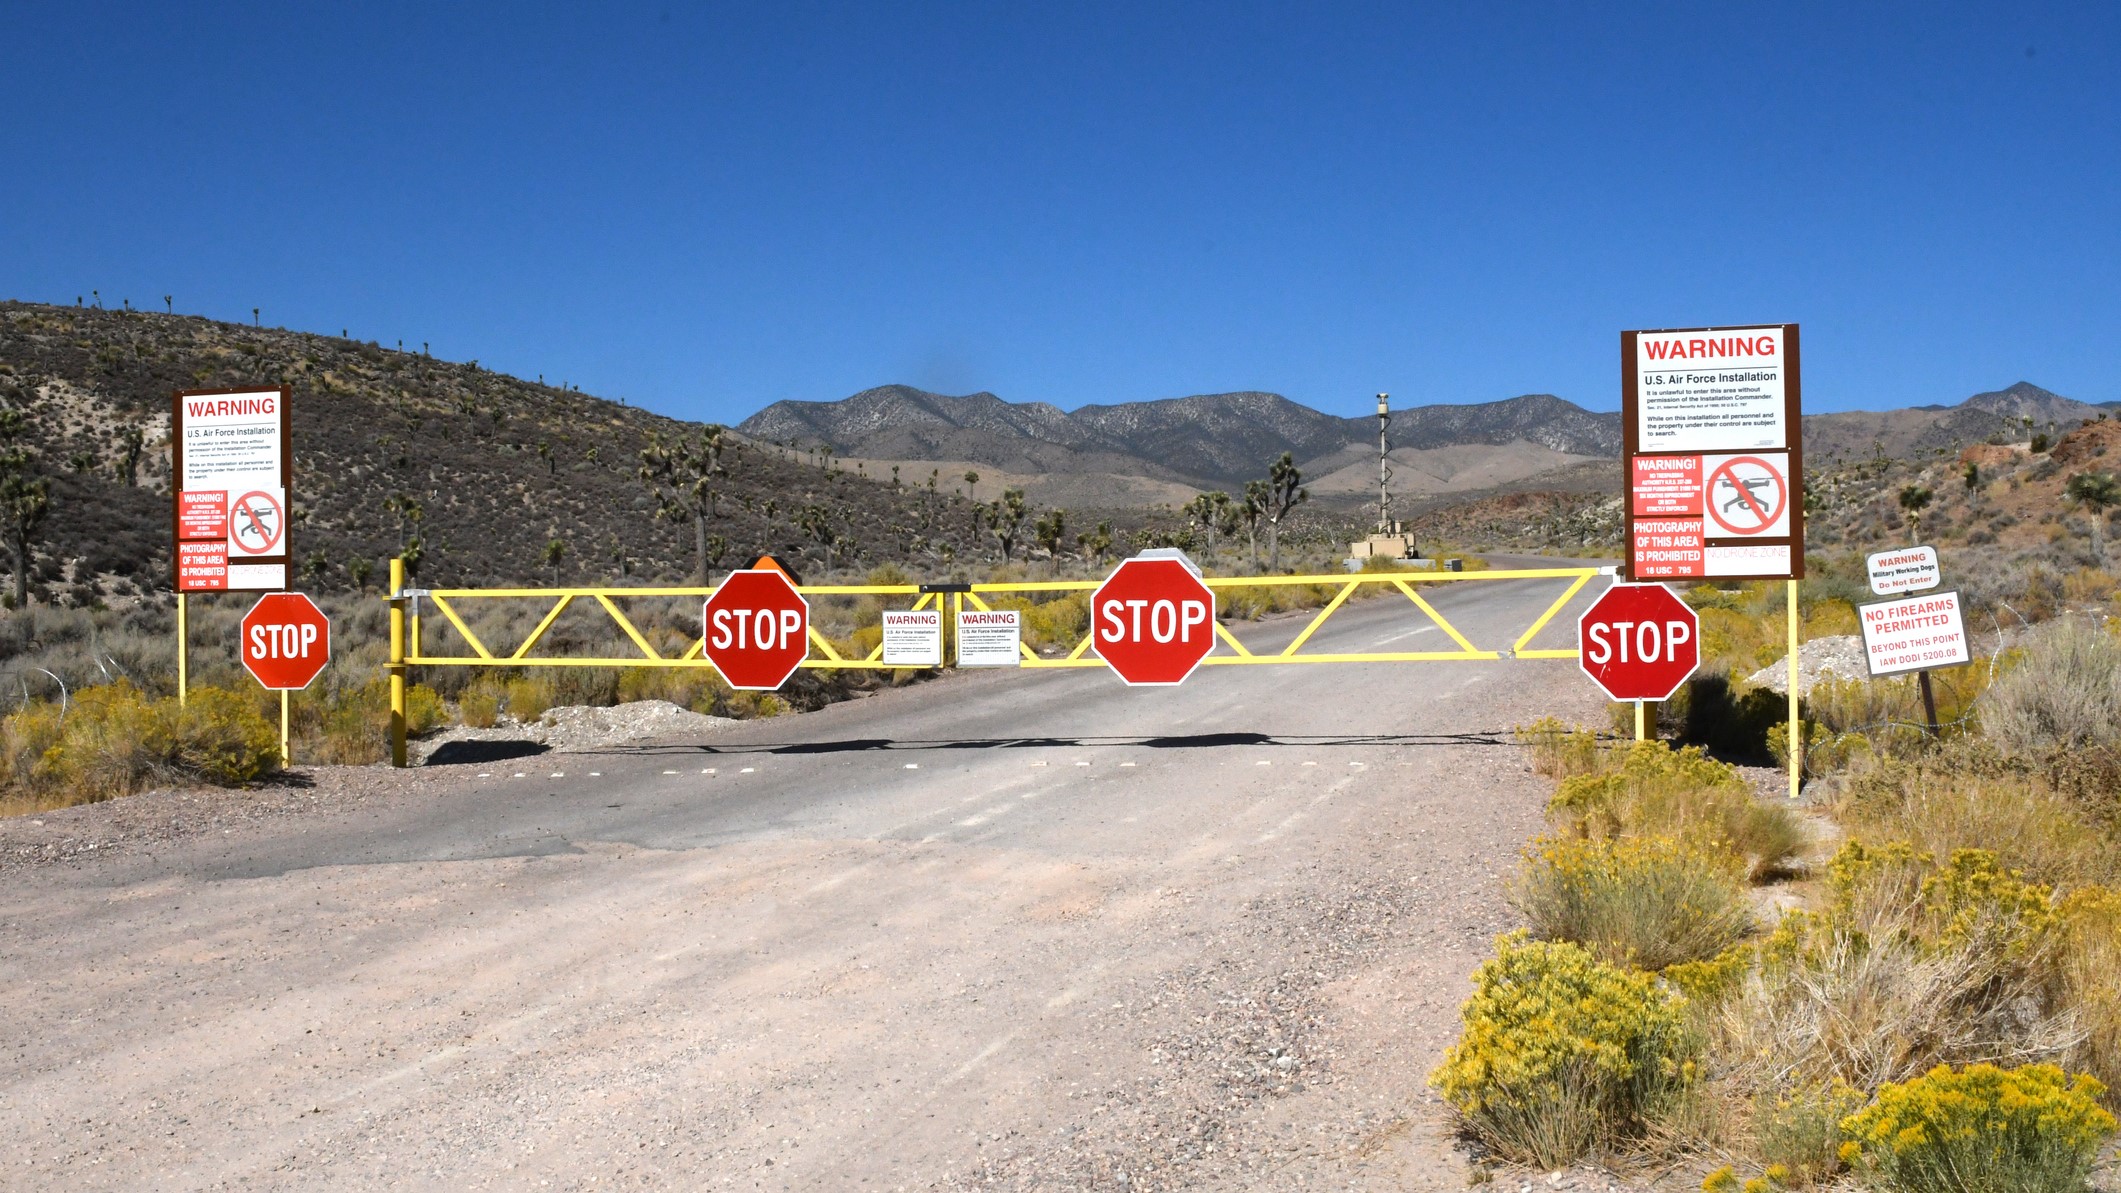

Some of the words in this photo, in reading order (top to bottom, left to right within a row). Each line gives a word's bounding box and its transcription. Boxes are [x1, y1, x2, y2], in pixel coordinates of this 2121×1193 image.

[1645, 336, 1775, 360] WARNING
[1645, 376, 1665, 385] U.S.
[1669, 375, 1683, 384] Air
[1686, 374, 1716, 383] Force
[1719, 372, 1776, 382] Installation
[188, 399, 274, 417] WARNING
[188, 430, 201, 438] U.S.
[237, 427, 275, 435] Installation
[1638, 459, 1696, 470] WARNING!
[184, 494, 223, 503] WARNING!
[1634, 522, 1702, 533] PHOTOGRAPHY
[1637, 537, 1649, 547] OF
[1652, 537, 1672, 546] THIS
[1674, 536, 1698, 546] AREA
[180, 544, 226, 553] PHOTOGRAPHY
[1707, 549, 1722, 558] NO
[1724, 548, 1758, 558] DRONE
[1760, 547, 1787, 558] ZONE
[192, 556, 206, 564] THIS
[207, 556, 224, 564] AREA
[1636, 552, 1644, 561] IS
[1647, 551, 1700, 561] PROHIBITED
[1878, 553, 1925, 567] WARNING
[182, 568, 187, 576] IS
[189, 567, 224, 576] PROHIBITED
[1896, 567, 1919, 575] Working
[1866, 610, 1884, 622] NO
[1888, 600, 1954, 618] FIREARMS
[887, 616, 936, 624] WARNING
[962, 614, 1014, 624] WARNING
[1101, 600, 1206, 643] STOP
[1875, 614, 1949, 634] PERMITTED
[712, 609, 801, 650] STOP
[250, 624, 317, 659] STOP
[1589, 621, 1690, 664] STOP
[1872, 641, 1907, 653] BEYOND
[1910, 638, 1930, 647] THIS
[1933, 633, 1959, 644] POINT
[1880, 657, 1896, 666] IAW
[1900, 654, 1920, 663] DODI
[1923, 648, 1957, 660] 5200.08
